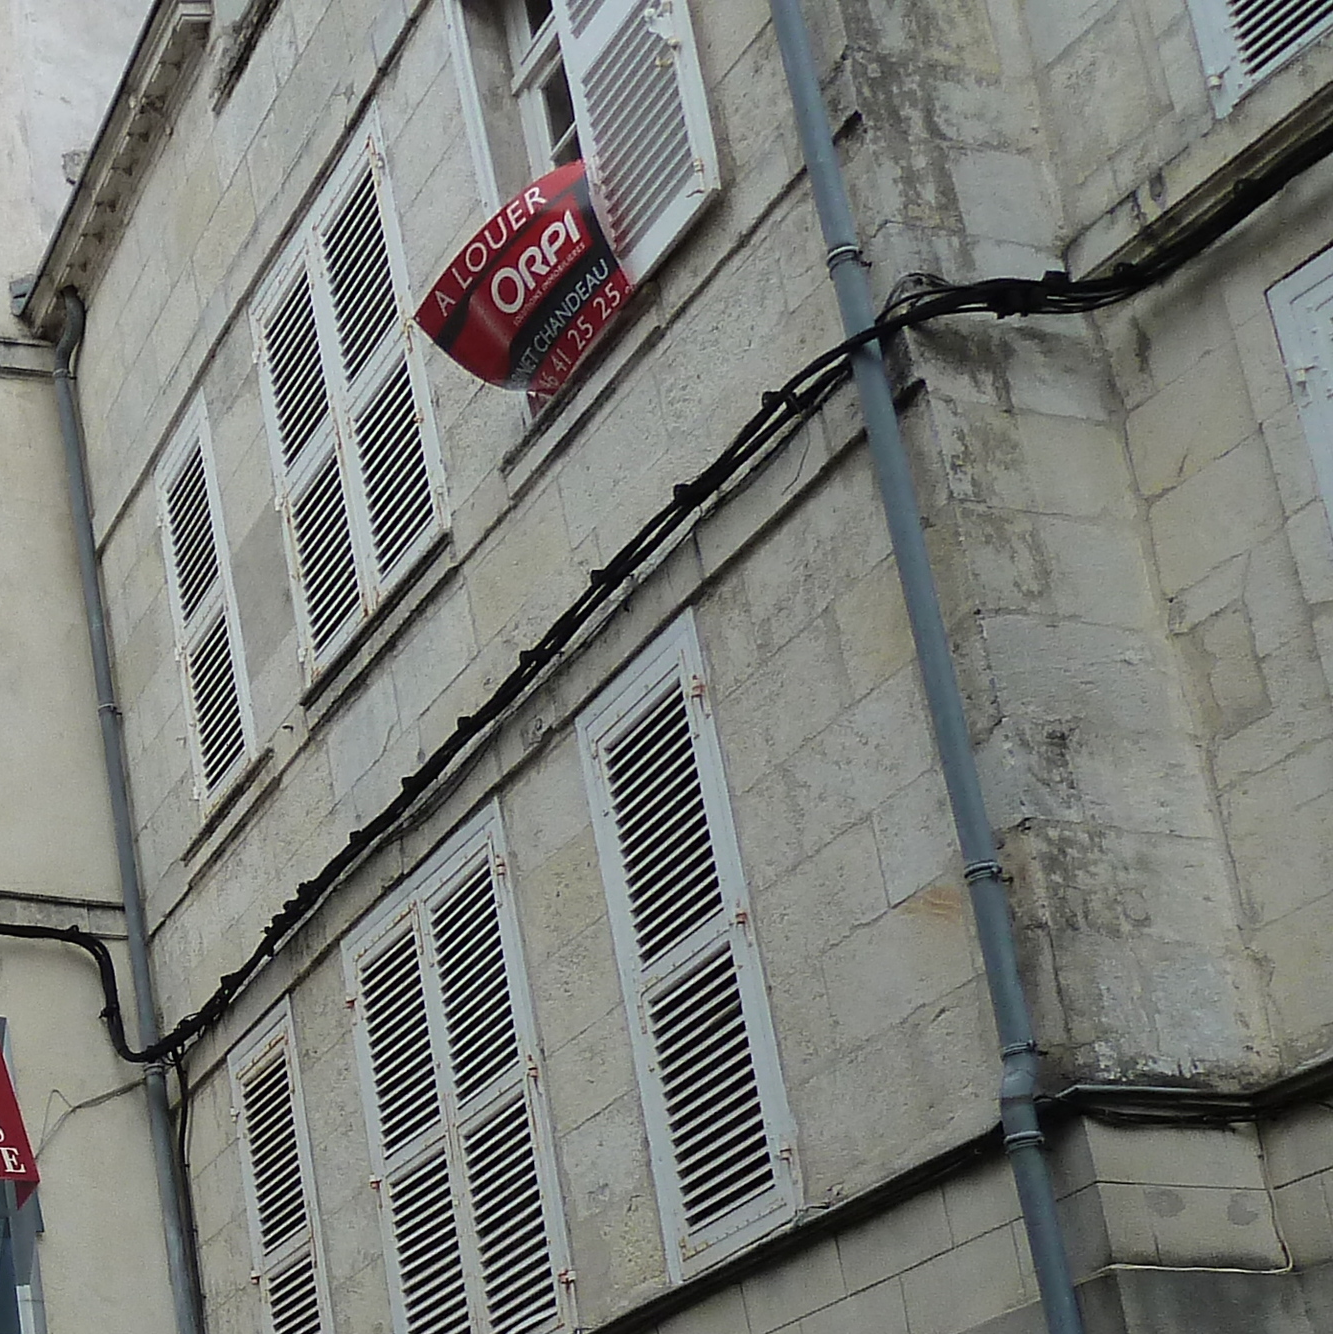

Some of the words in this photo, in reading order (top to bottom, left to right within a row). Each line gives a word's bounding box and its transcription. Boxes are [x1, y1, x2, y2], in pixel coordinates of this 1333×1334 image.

[435, 289, 456, 318] A
[451, 185, 547, 291] LOUER
[490, 209, 583, 315] ORPI
[533, 257, 610, 355] CHANDEAU
[551, 347, 572, 372] 41
[567, 315, 594, 351] 25
[592, 281, 621, 321] 25
